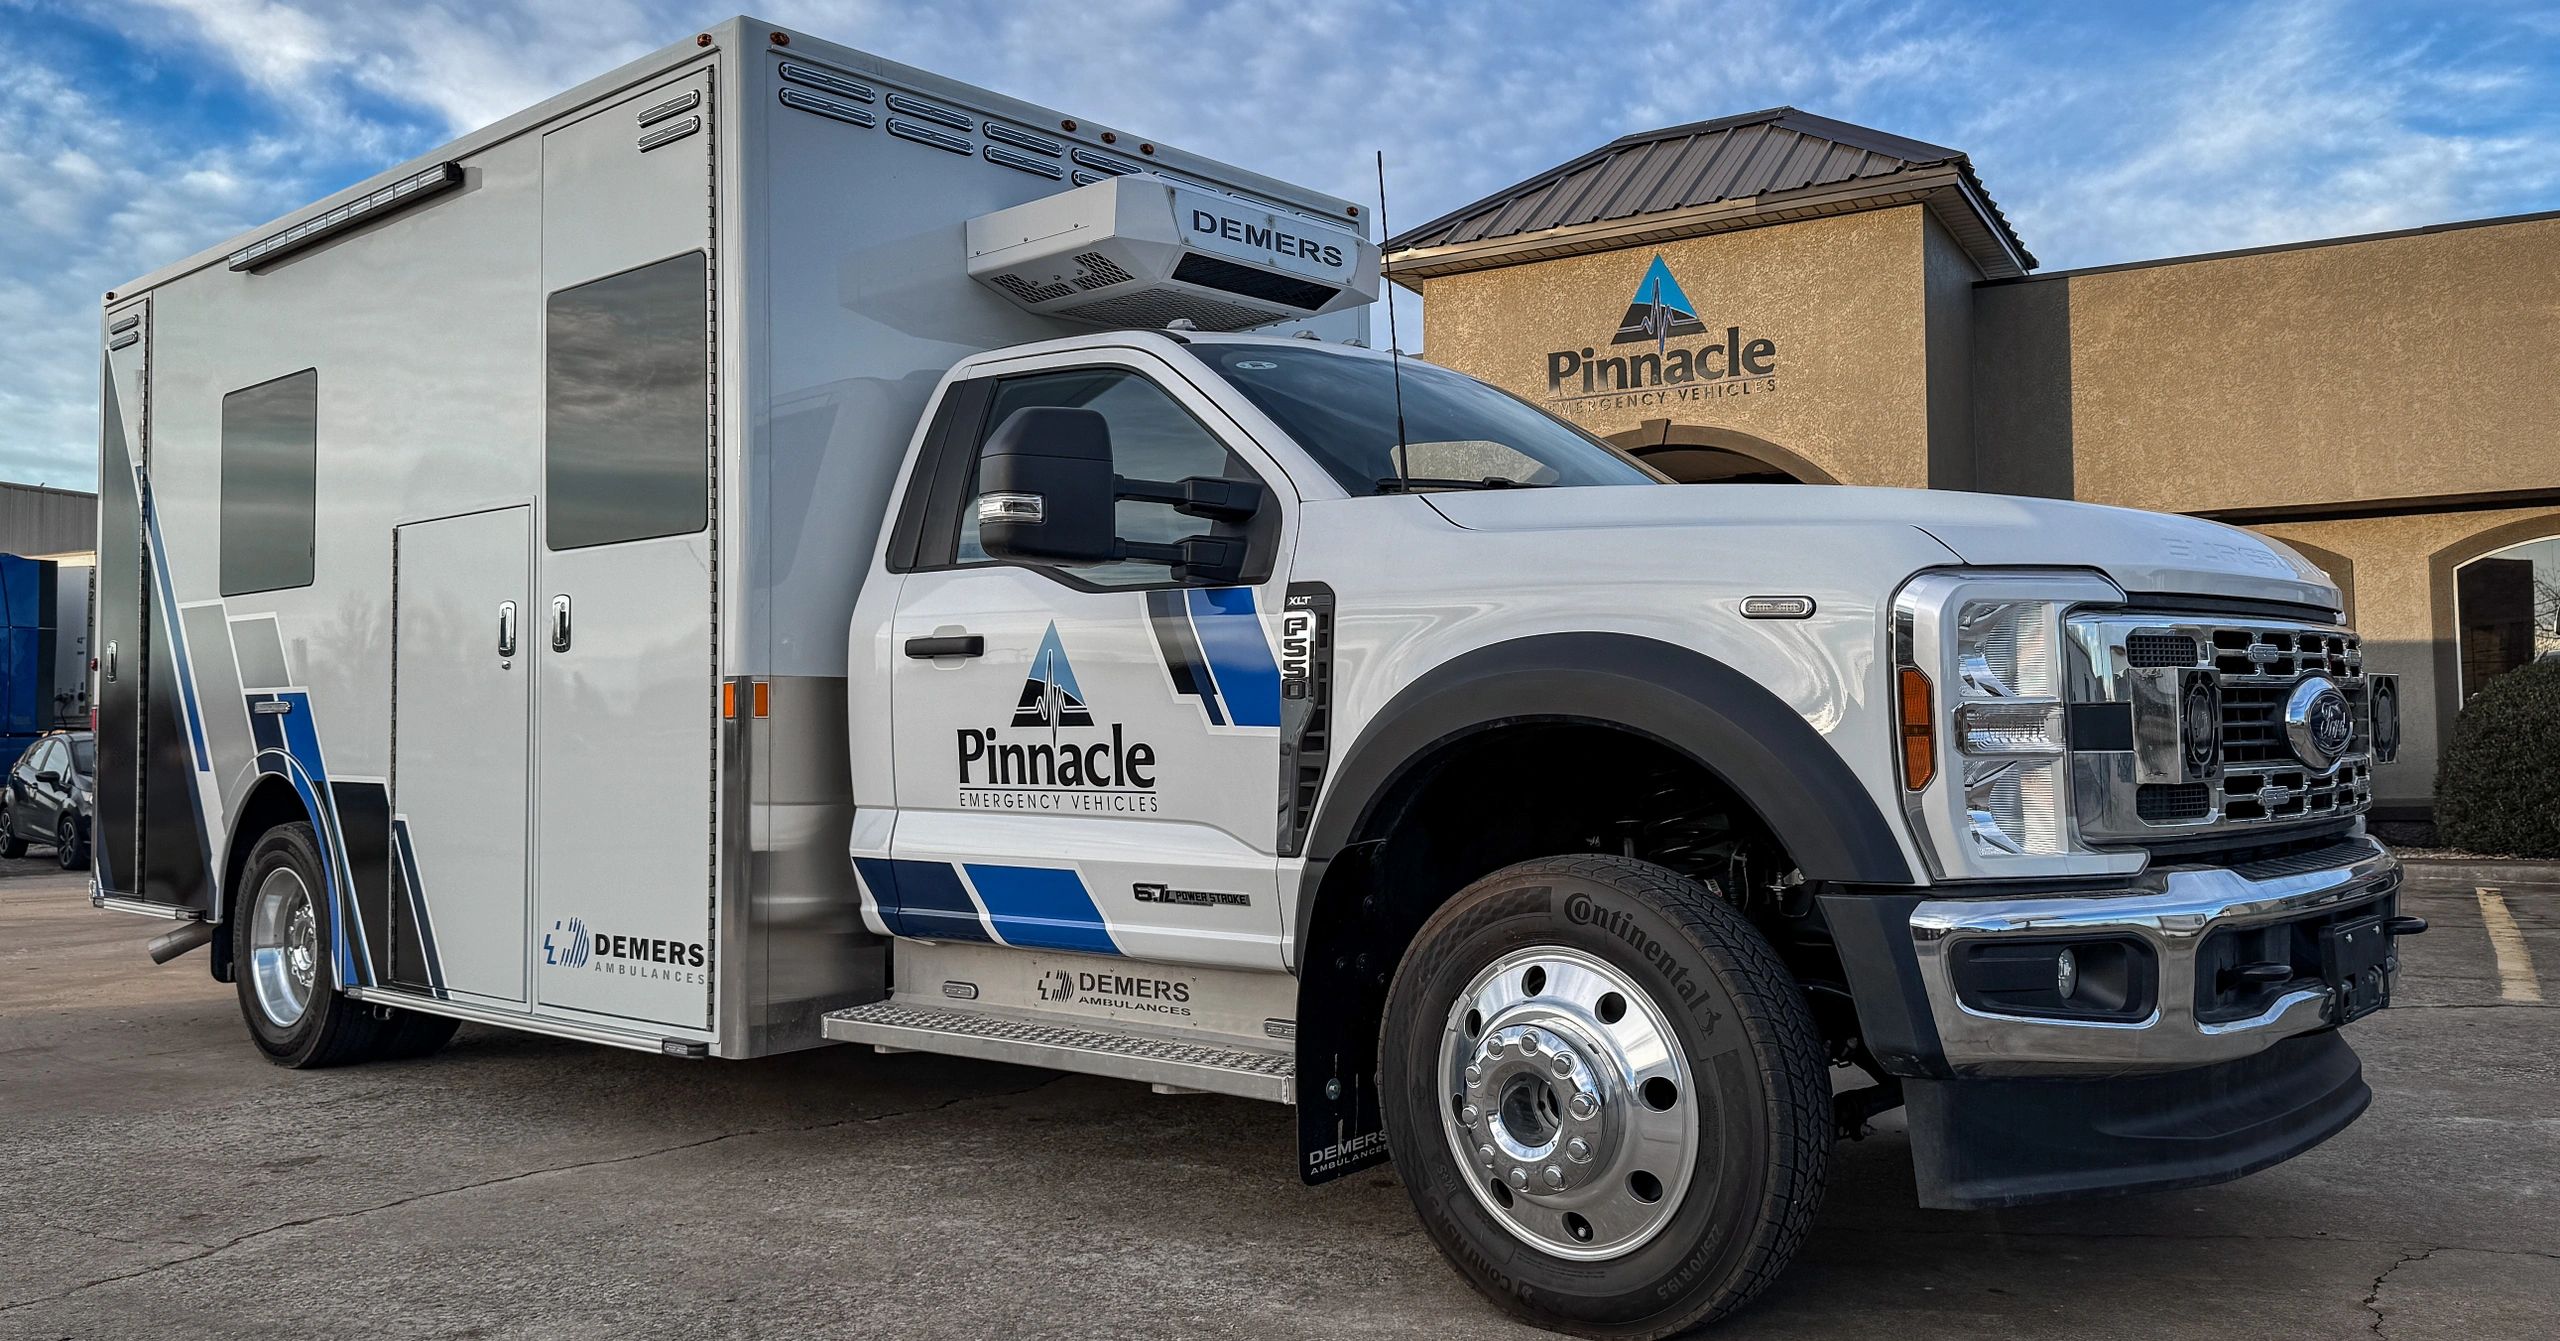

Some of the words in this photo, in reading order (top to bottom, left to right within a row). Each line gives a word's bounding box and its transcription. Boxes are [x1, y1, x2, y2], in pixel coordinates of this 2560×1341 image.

[1192, 209, 1343, 267] DEMERS
[1547, 326, 1776, 396] Pinnacle
[1678, 379, 1776, 402] VEHICLES
[1288, 595, 1312, 606] XLT
[2320, 701, 2349, 741] Ford
[956, 723, 1156, 789] Pinnacle
[959, 792, 1061, 810] EMERGENCY
[1071, 795, 1158, 813] VEHICLES
[1176, 890, 1207, 903] POWER
[1208, 892, 1247, 905] STROKE
[594, 933, 705, 968] DEMERS
[1564, 892, 1711, 1013] Continental
[594, 961, 705, 985] AMBULANCES
[1079, 972, 1190, 1003] DEMERS
[1079, 996, 1191, 1016] AMBULANCES
[1309, 1129, 1387, 1165] DEMERS
[1310, 1144, 1388, 1175] AMBULANCE
